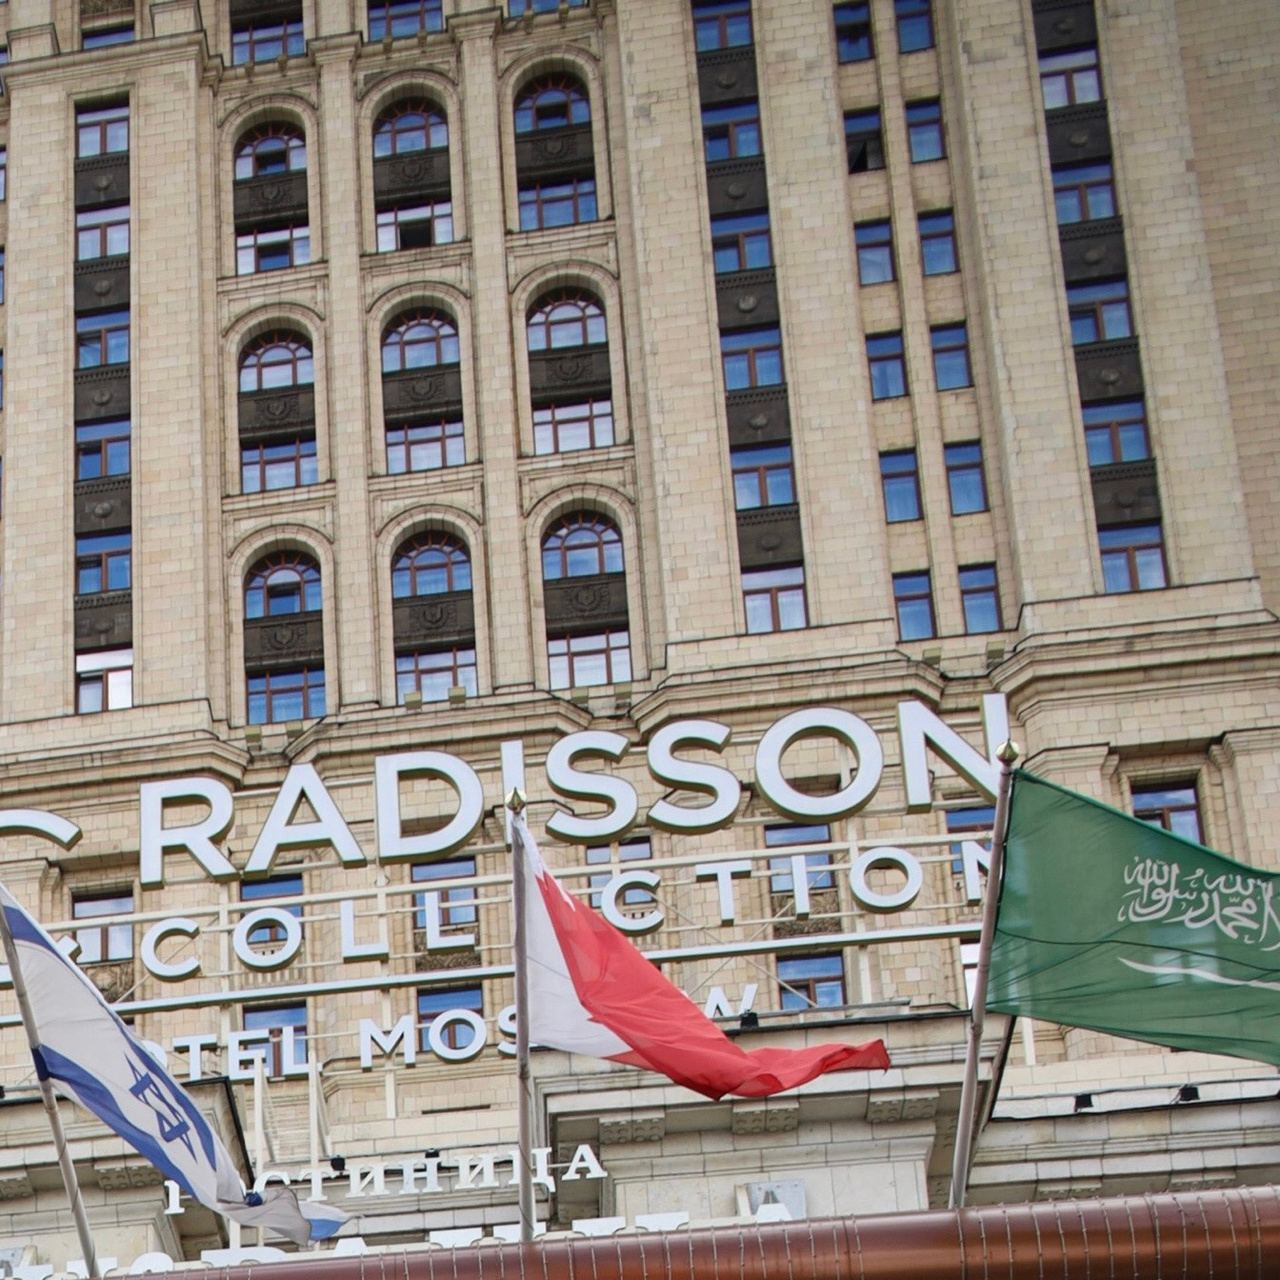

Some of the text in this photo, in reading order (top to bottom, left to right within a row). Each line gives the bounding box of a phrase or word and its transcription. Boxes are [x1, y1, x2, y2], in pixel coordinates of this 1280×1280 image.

[139, 693, 1010, 891] RADISSON
[140, 840, 994, 983] COLLCTION
[151, 1025, 324, 1083] TEL
